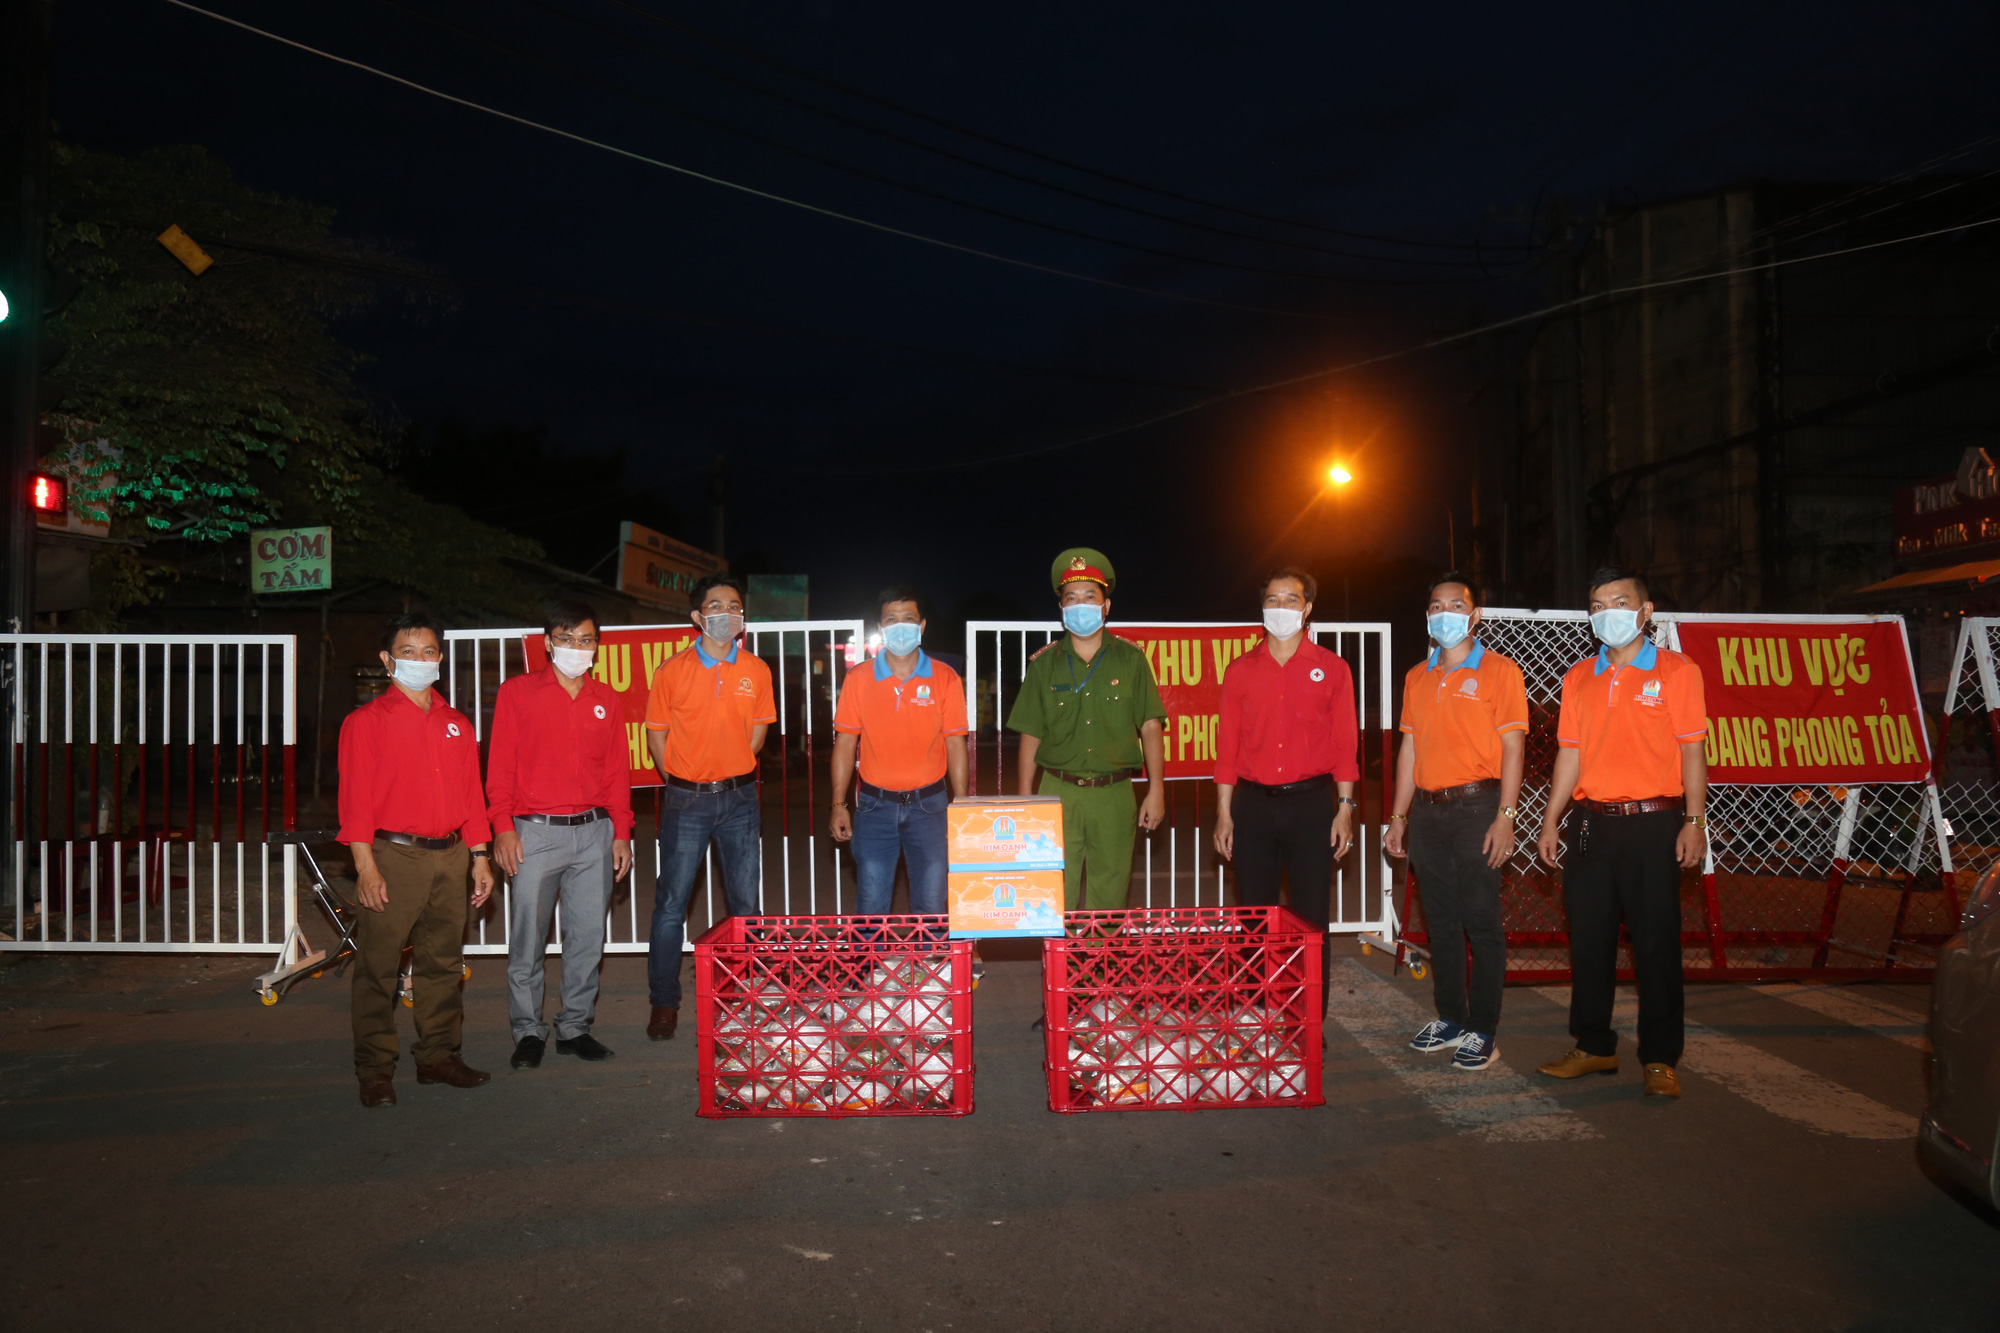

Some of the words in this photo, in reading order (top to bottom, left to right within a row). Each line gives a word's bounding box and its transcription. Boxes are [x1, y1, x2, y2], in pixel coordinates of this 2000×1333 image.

[257, 531, 325, 562] CƠM
[260, 562, 322, 590] TẤM
[592, 644, 631, 692] HU
[1717, 637, 1793, 687] KHU
[1798, 633, 1871, 696] VỰC
[1178, 714, 1220, 762] PHO
[1774, 715, 1866, 767] PHONG
[1864, 697, 1923, 765] TỎA
